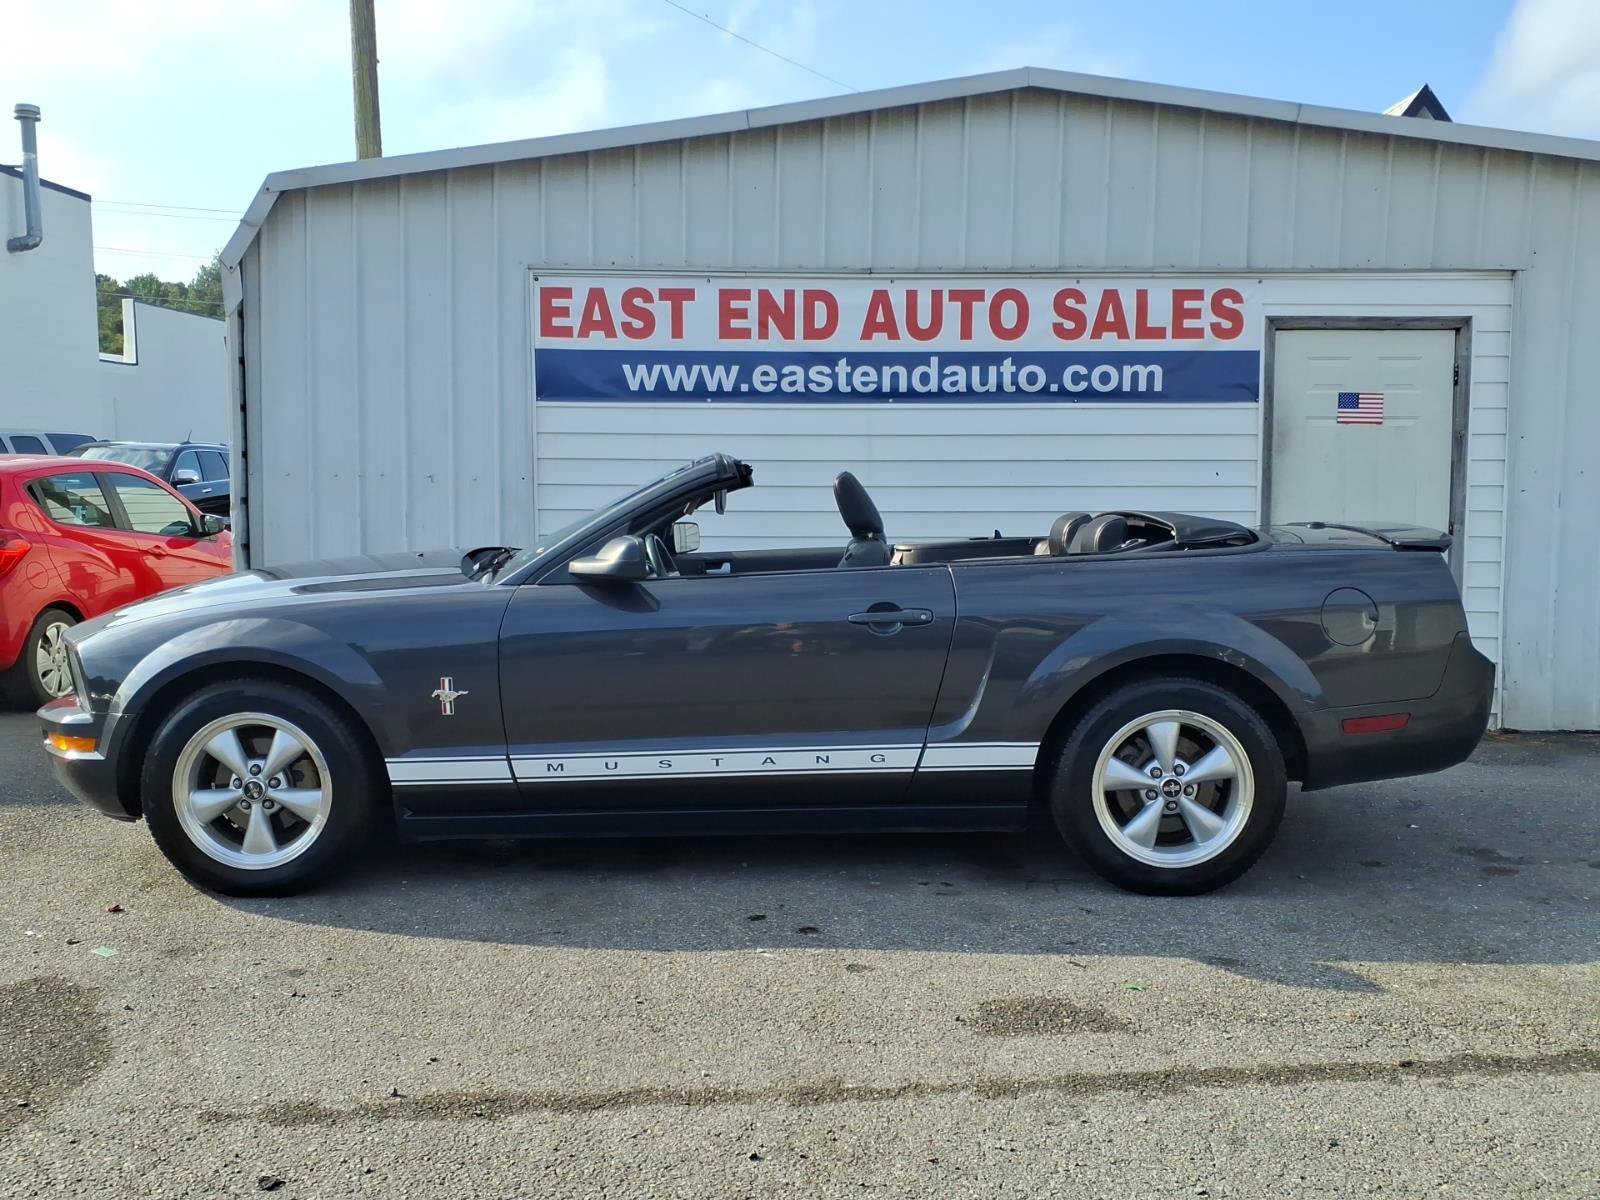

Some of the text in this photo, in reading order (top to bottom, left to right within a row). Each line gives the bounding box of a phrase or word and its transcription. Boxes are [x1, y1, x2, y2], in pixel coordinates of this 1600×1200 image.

[538, 286, 1245, 342] EAST END AUTO SALES
[622, 357, 1163, 393] www.eastendauto.com
[546, 753, 886, 772] MUSTANG
